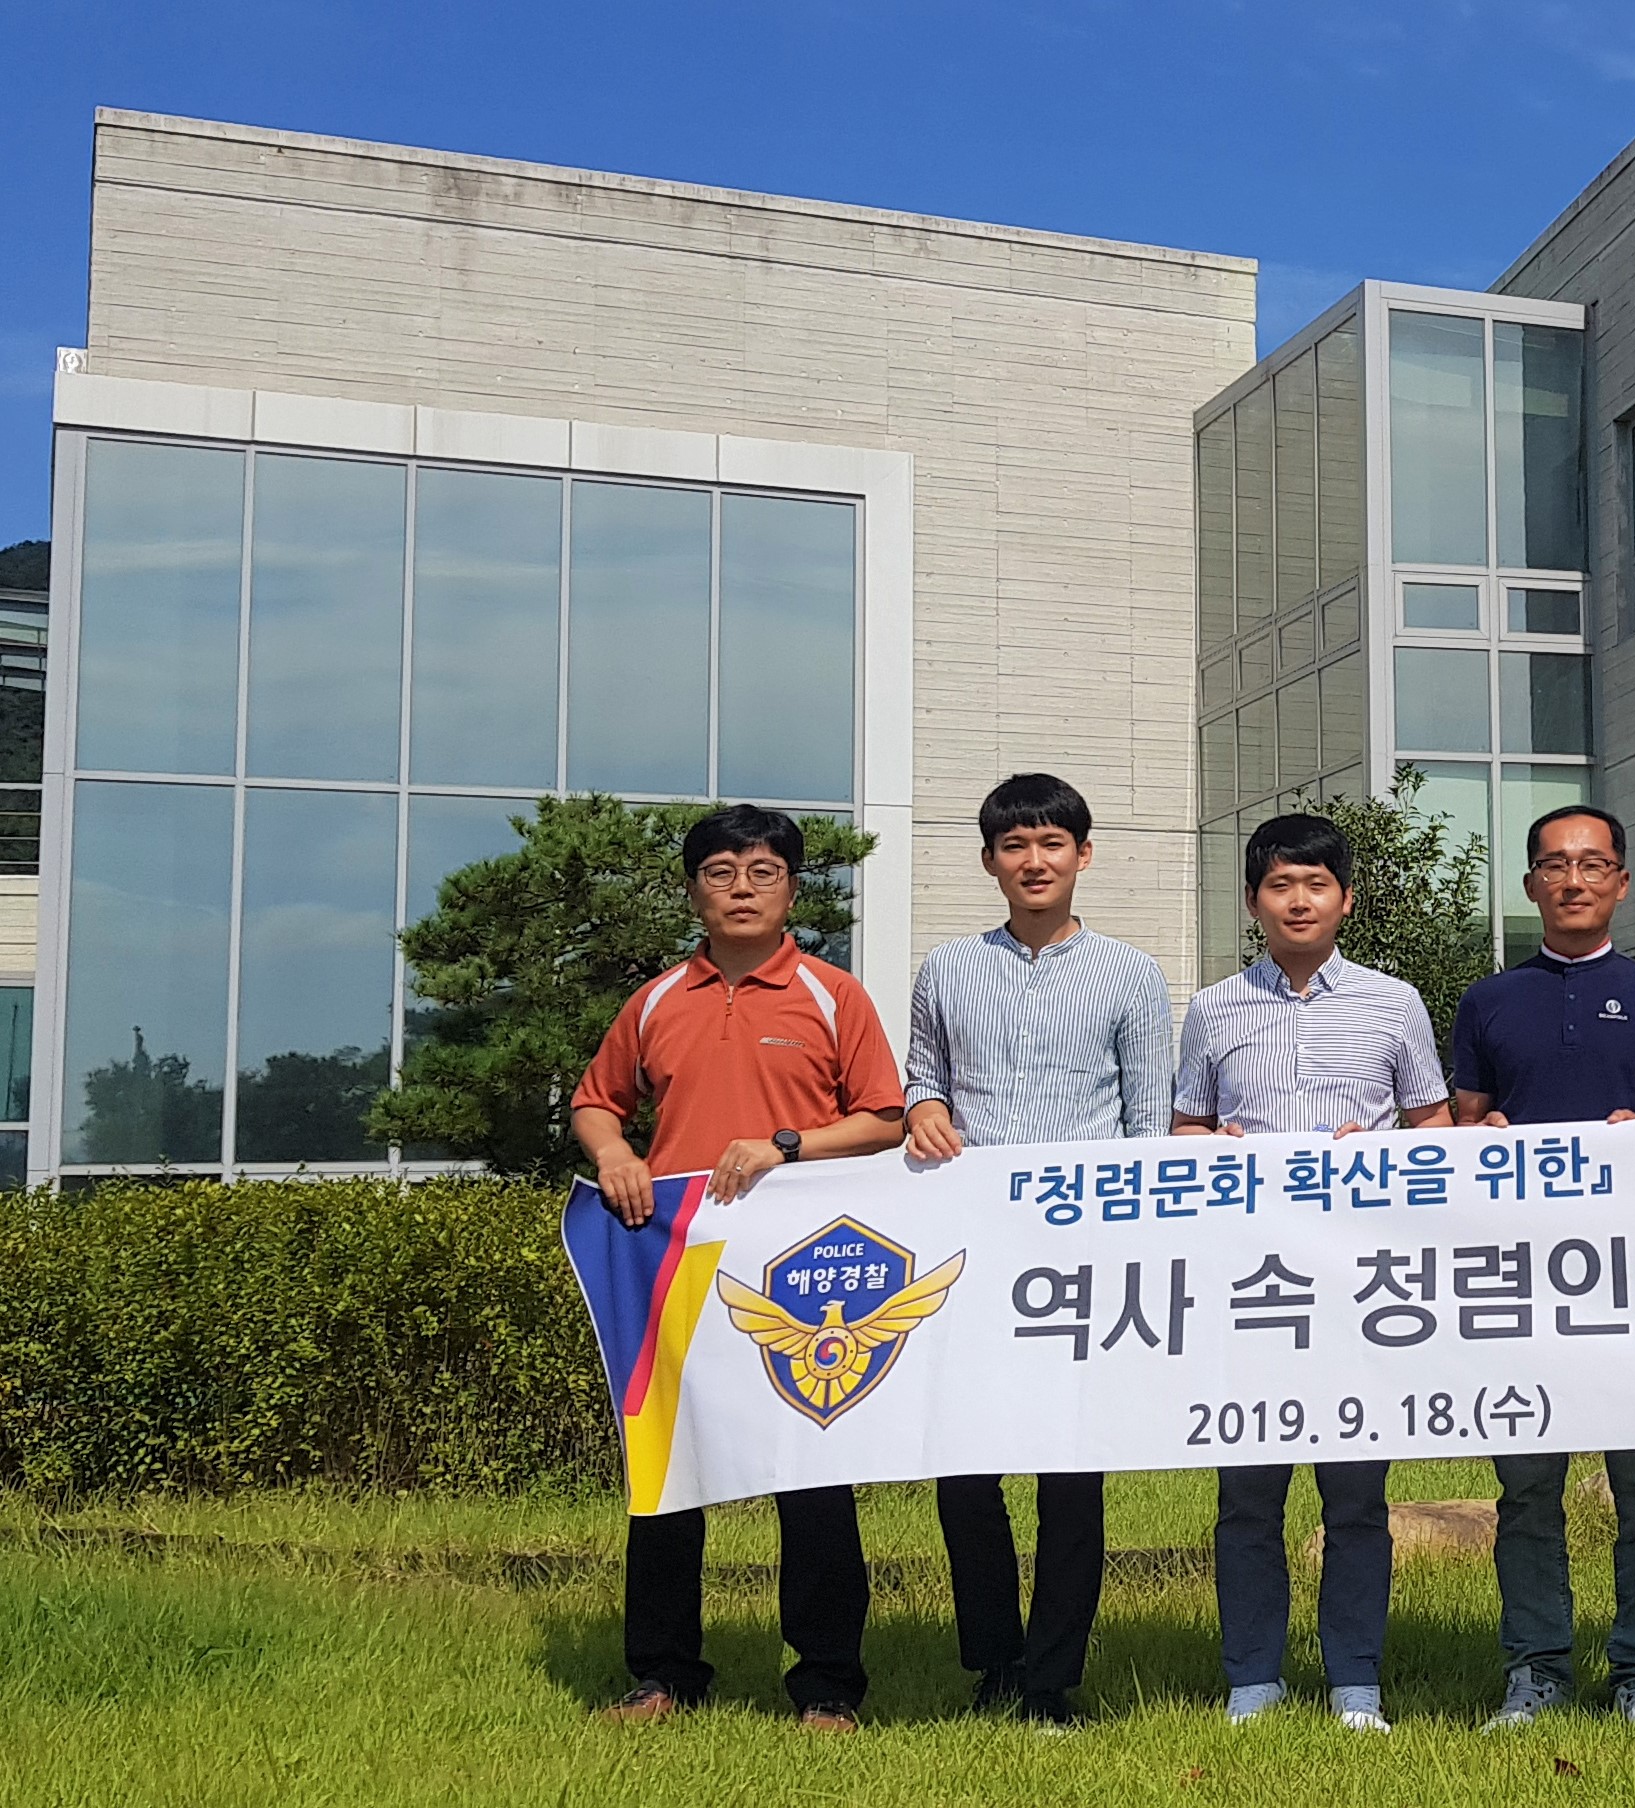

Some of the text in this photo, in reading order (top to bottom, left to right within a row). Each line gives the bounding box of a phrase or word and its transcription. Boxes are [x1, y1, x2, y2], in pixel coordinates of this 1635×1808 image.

[1283, 1143, 1455, 1212] 확산을
[786, 1263, 889, 1295] 해양경찰
[813, 1243, 865, 1260] POLICE
[1011, 1258, 1195, 1362] 역사
[1229, 1253, 1315, 1350] 속
[1186, 1384, 1551, 1446] 2019. 9. 18.(수)
